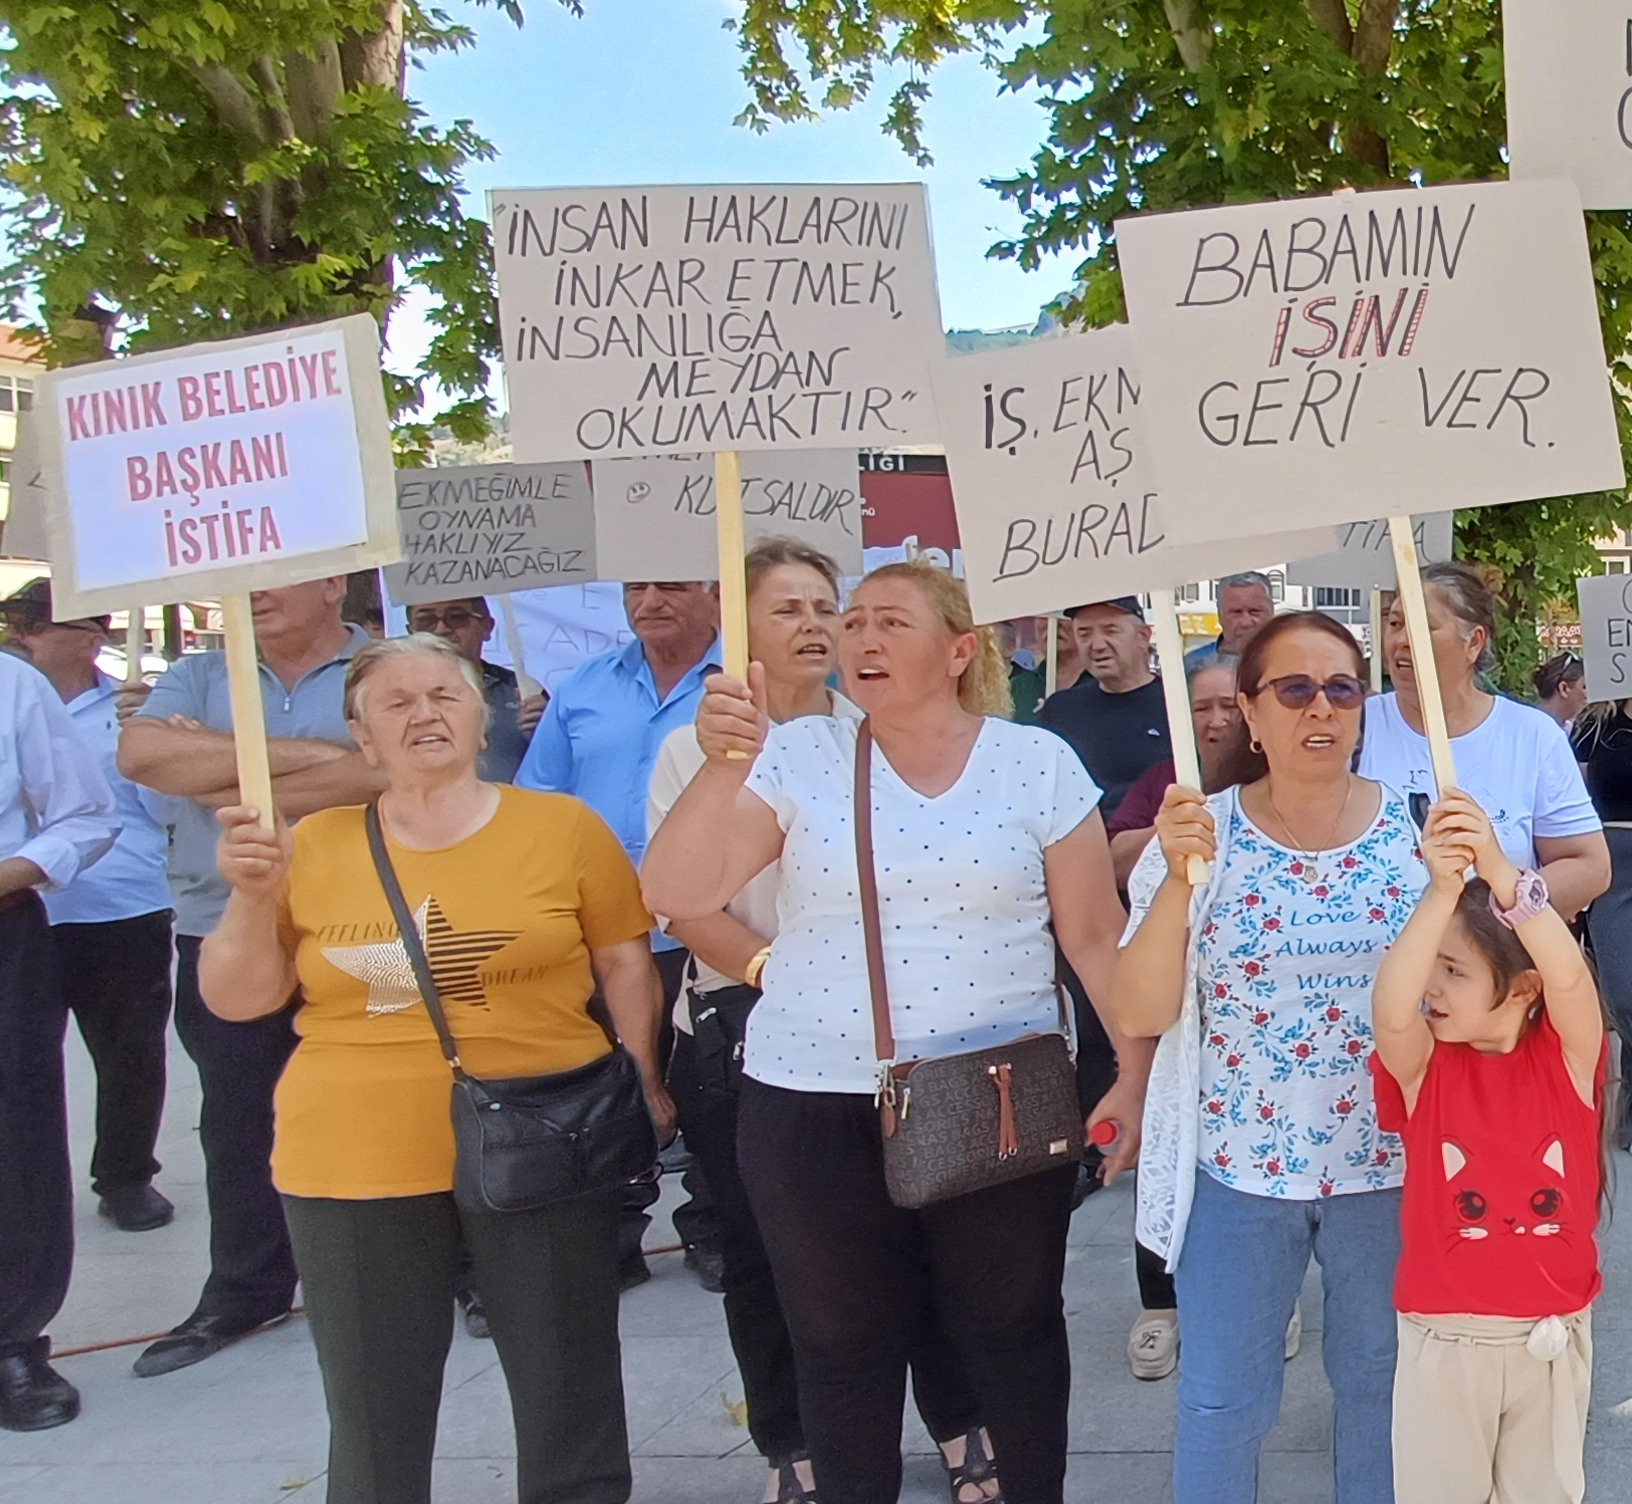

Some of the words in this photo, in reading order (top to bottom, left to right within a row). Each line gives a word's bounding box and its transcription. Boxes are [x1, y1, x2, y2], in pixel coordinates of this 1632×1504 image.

[684, 194, 909, 250] HAKLARINI
[1175, 203, 1476, 308] BABAMIN
[555, 258, 712, 308] İNKAR
[726, 258, 903, 319] ETMEK,
[517, 305, 783, 362] İNSANLIĞA
[65, 380, 168, 442] KINIK
[176, 345, 343, 423] BELEDİYE
[636, 347, 850, 402] MEYDAN
[1198, 362, 1368, 449] GERİ
[1417, 366, 1555, 449] VER.
[126, 431, 289, 507] BAŞKANI
[163, 500, 282, 568] İSTİFA
[418, 503, 537, 531] OYNAMA
[404, 546, 587, 587] KAZANACAĞIZ
[1290, 909, 1363, 927] Love
[1275, 937, 1380, 959] Always
[1296, 973, 1374, 990] Wins
